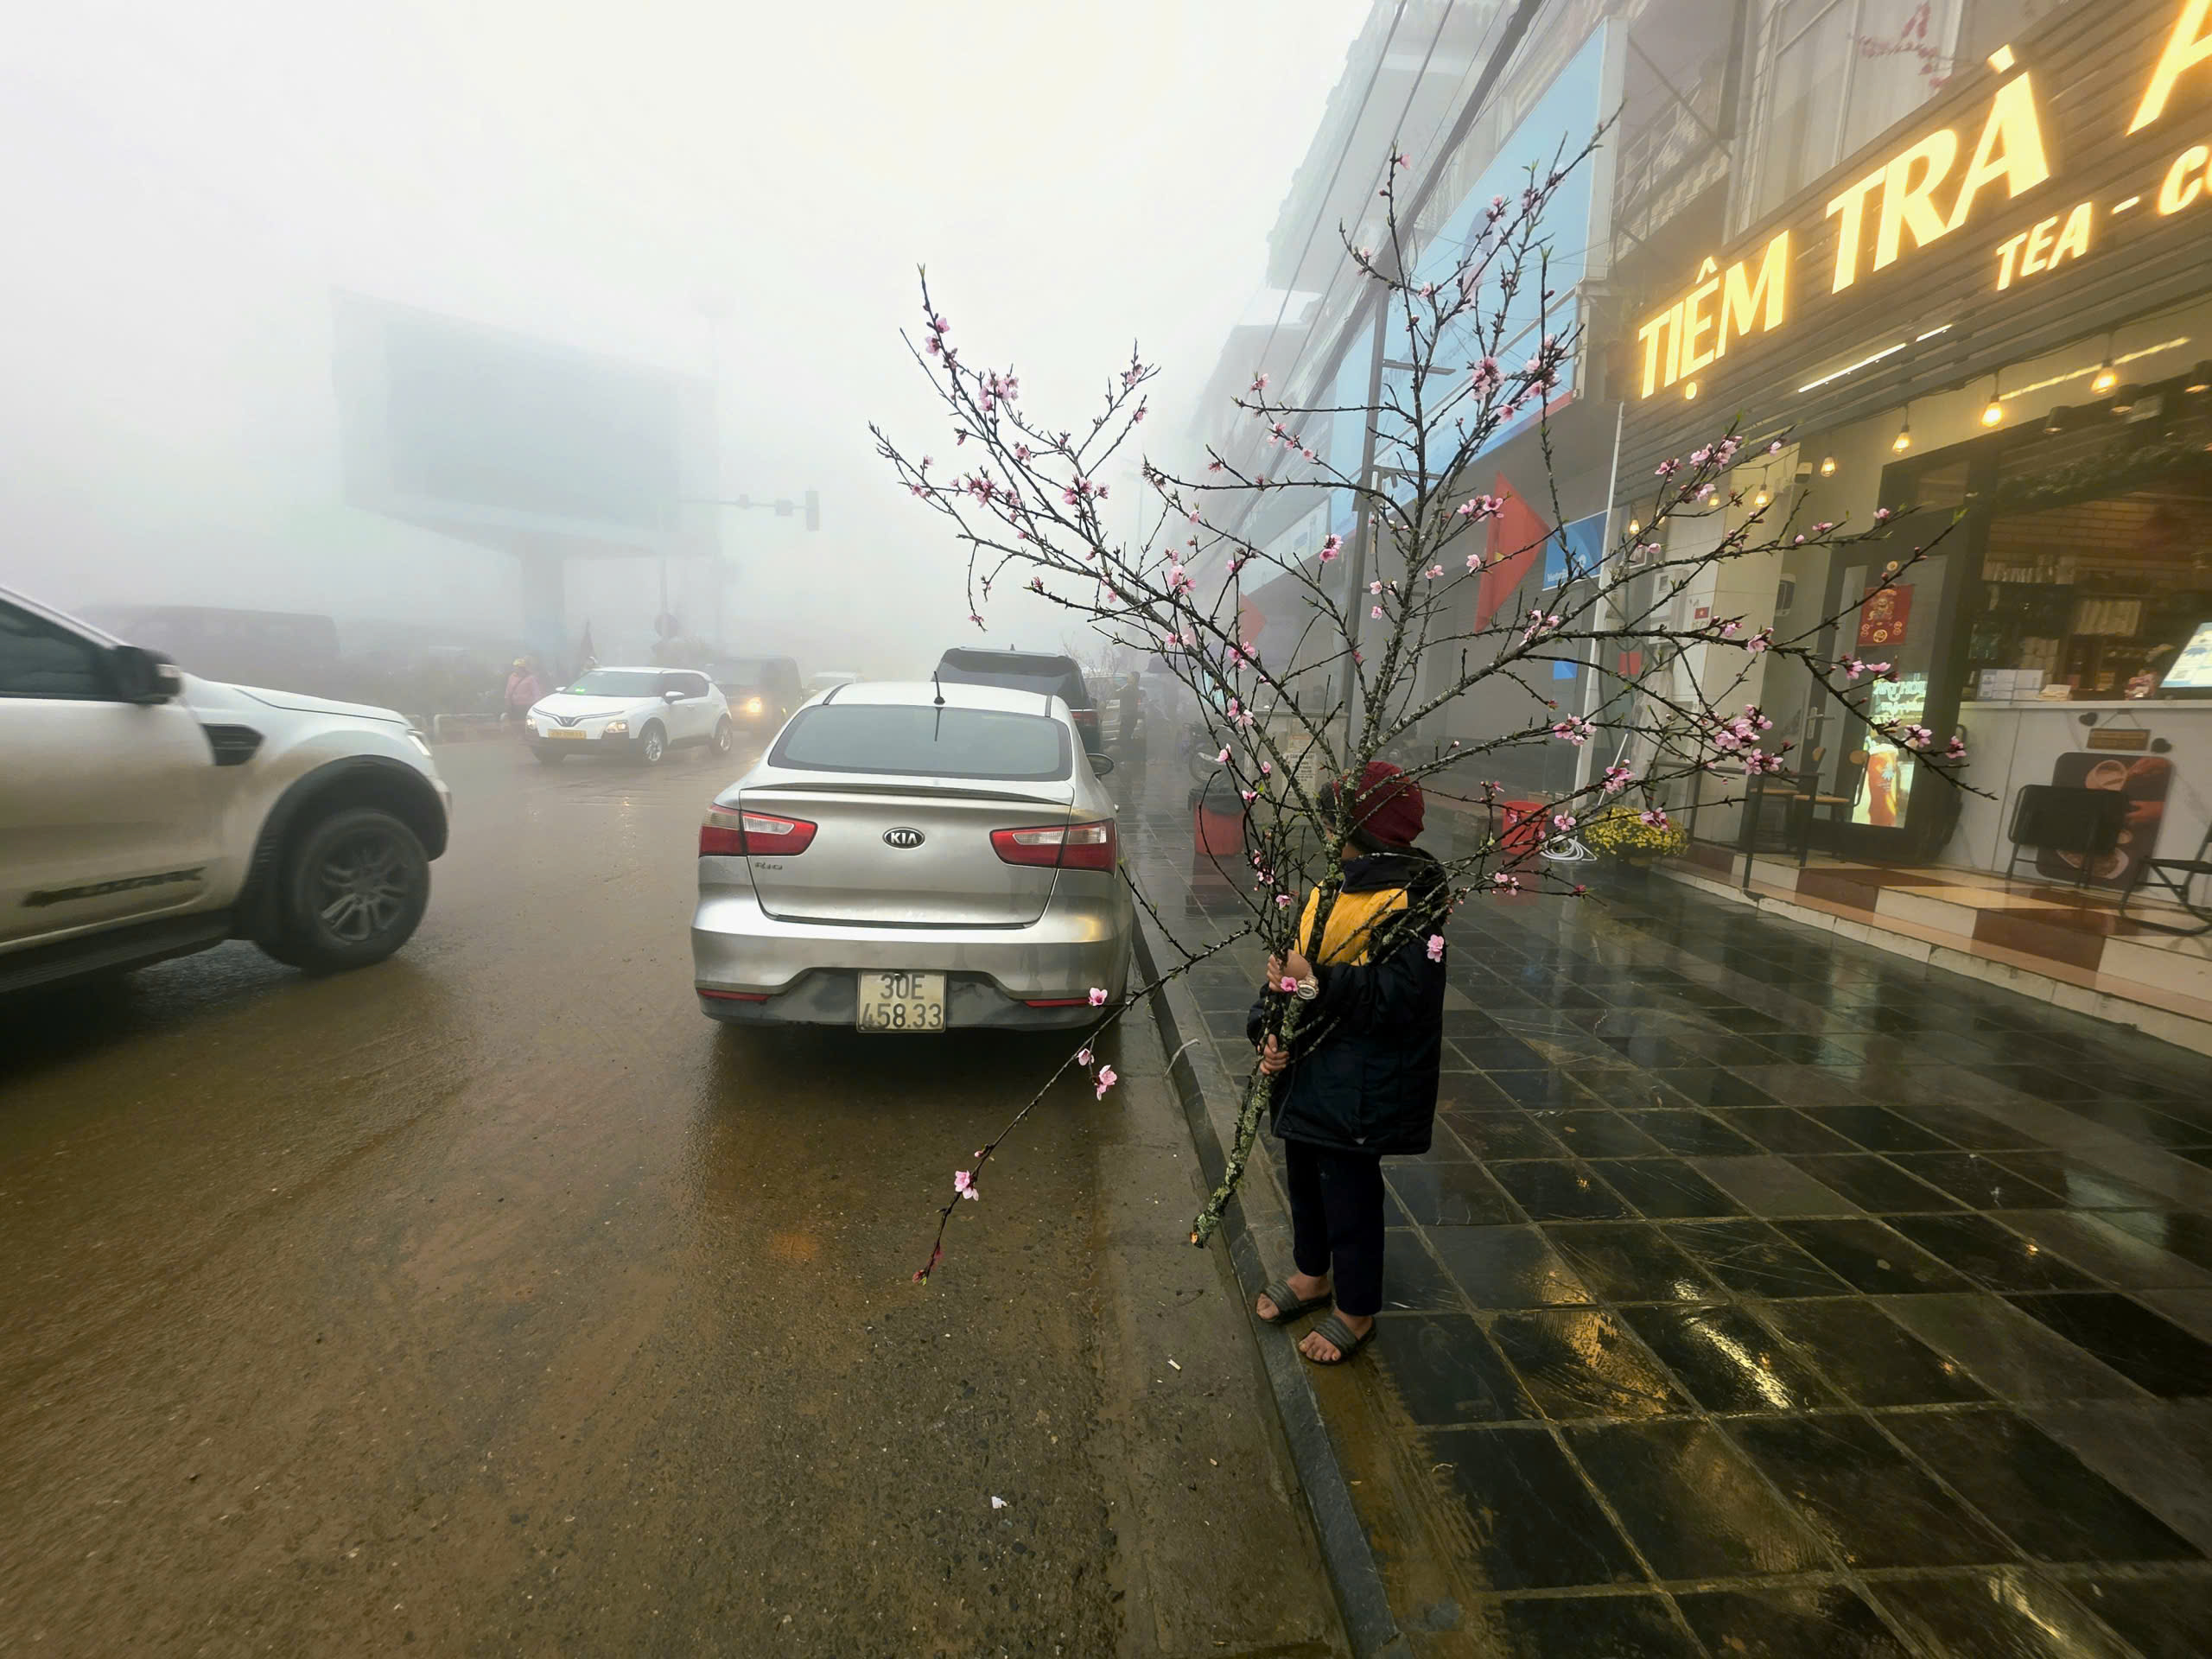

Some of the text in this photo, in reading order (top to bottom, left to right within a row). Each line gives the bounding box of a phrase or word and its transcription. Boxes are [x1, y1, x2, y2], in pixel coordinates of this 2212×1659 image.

[1638, 230, 1789, 400] TIỆM
[1825, 43, 2050, 295] TRÀ
[1996, 201, 2093, 291] TEA
[891, 832, 918, 844] KIA
[880, 974, 925, 1000] 30E
[862, 1003, 942, 1028] 458.33
